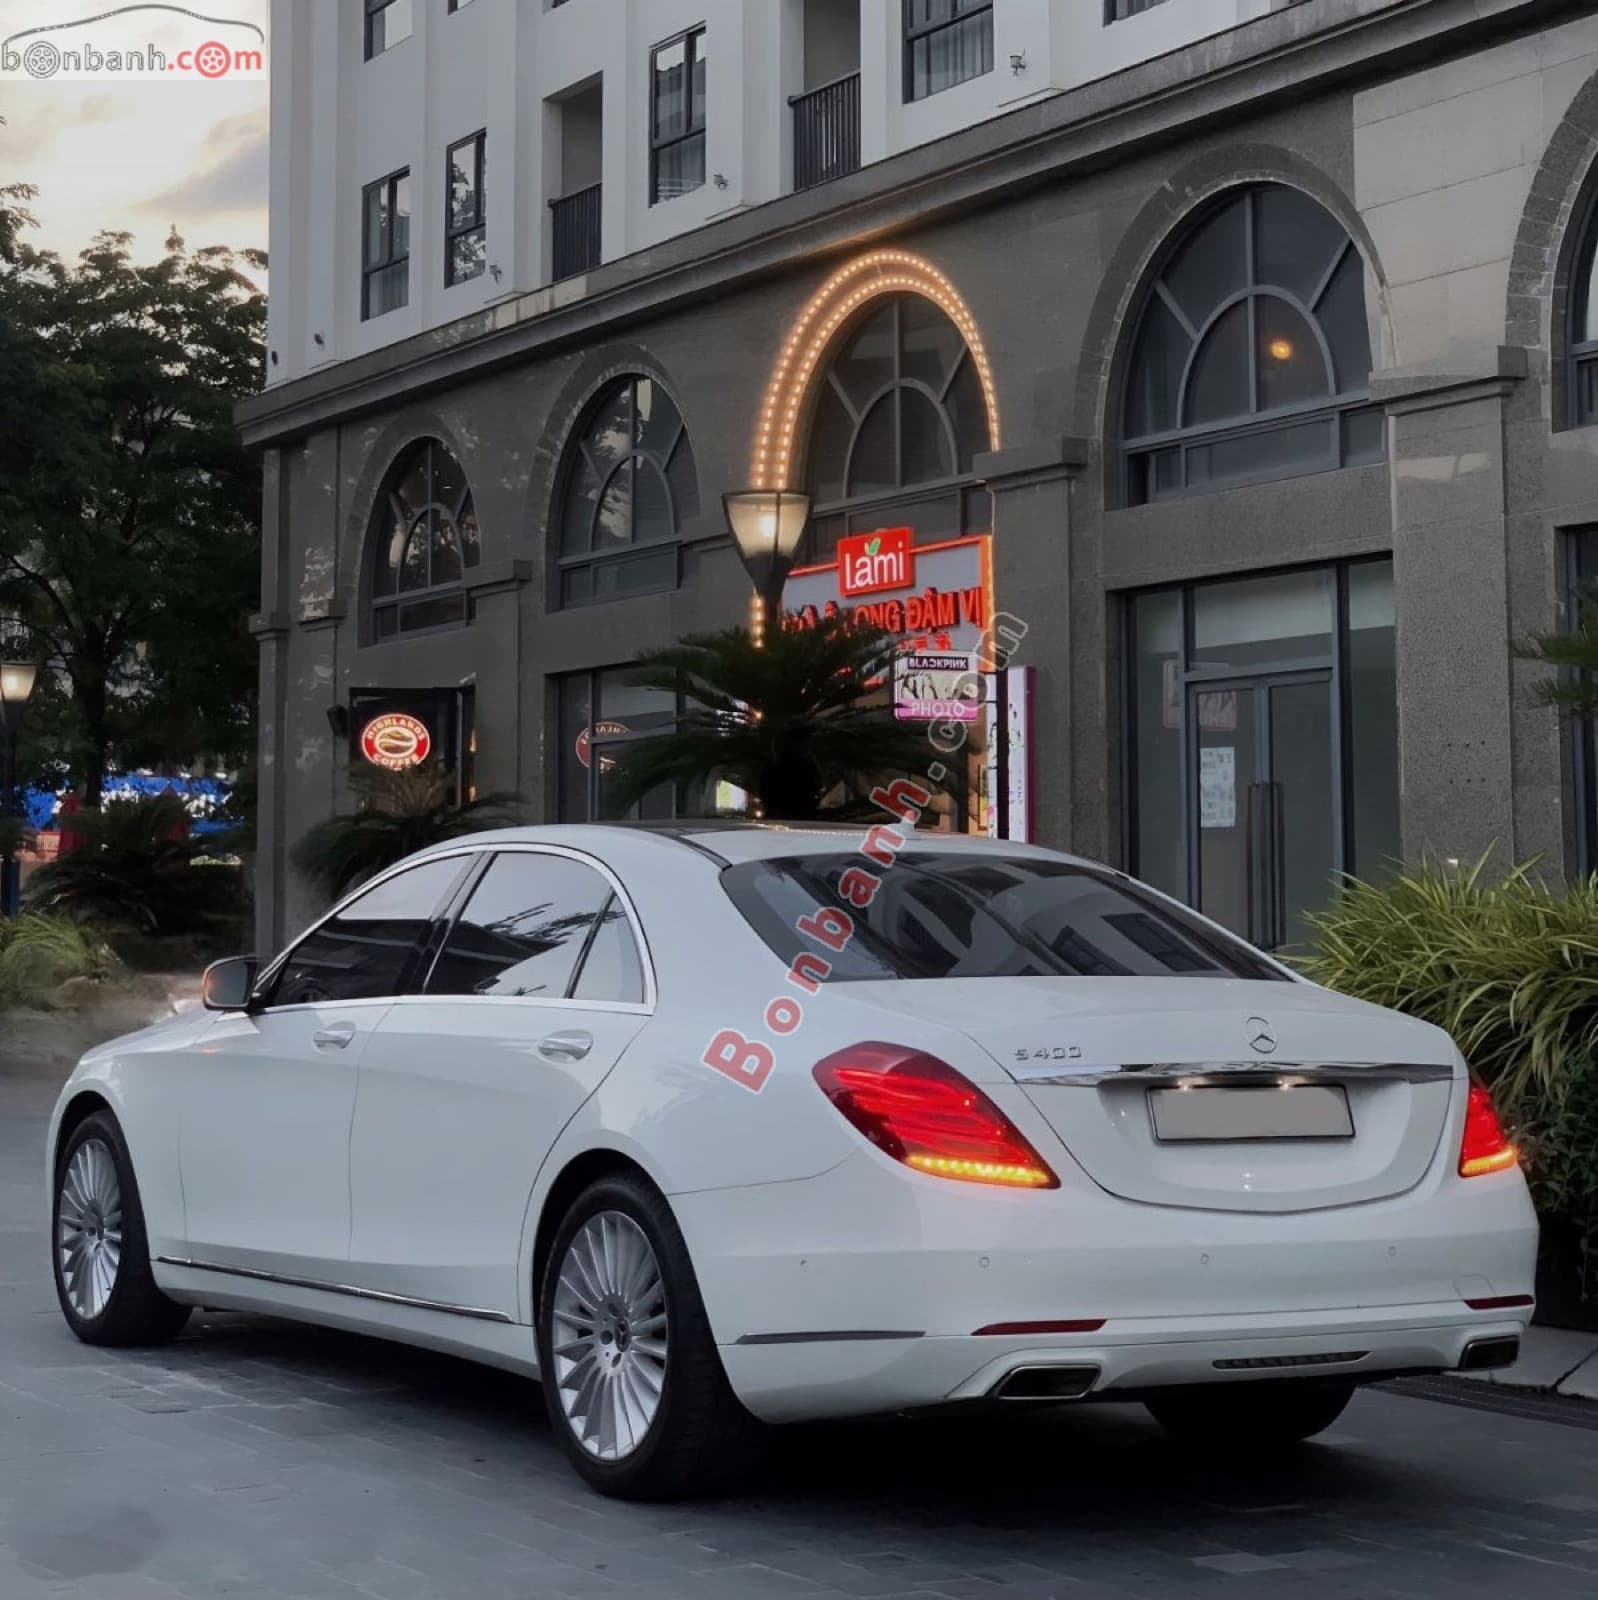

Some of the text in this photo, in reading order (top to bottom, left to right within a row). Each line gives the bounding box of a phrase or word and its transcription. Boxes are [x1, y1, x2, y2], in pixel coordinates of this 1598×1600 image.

[906, 587, 958, 634] ĐẬM
[911, 702, 966, 716] PHOTO
[365, 716, 426, 740] HIGHLANDS
